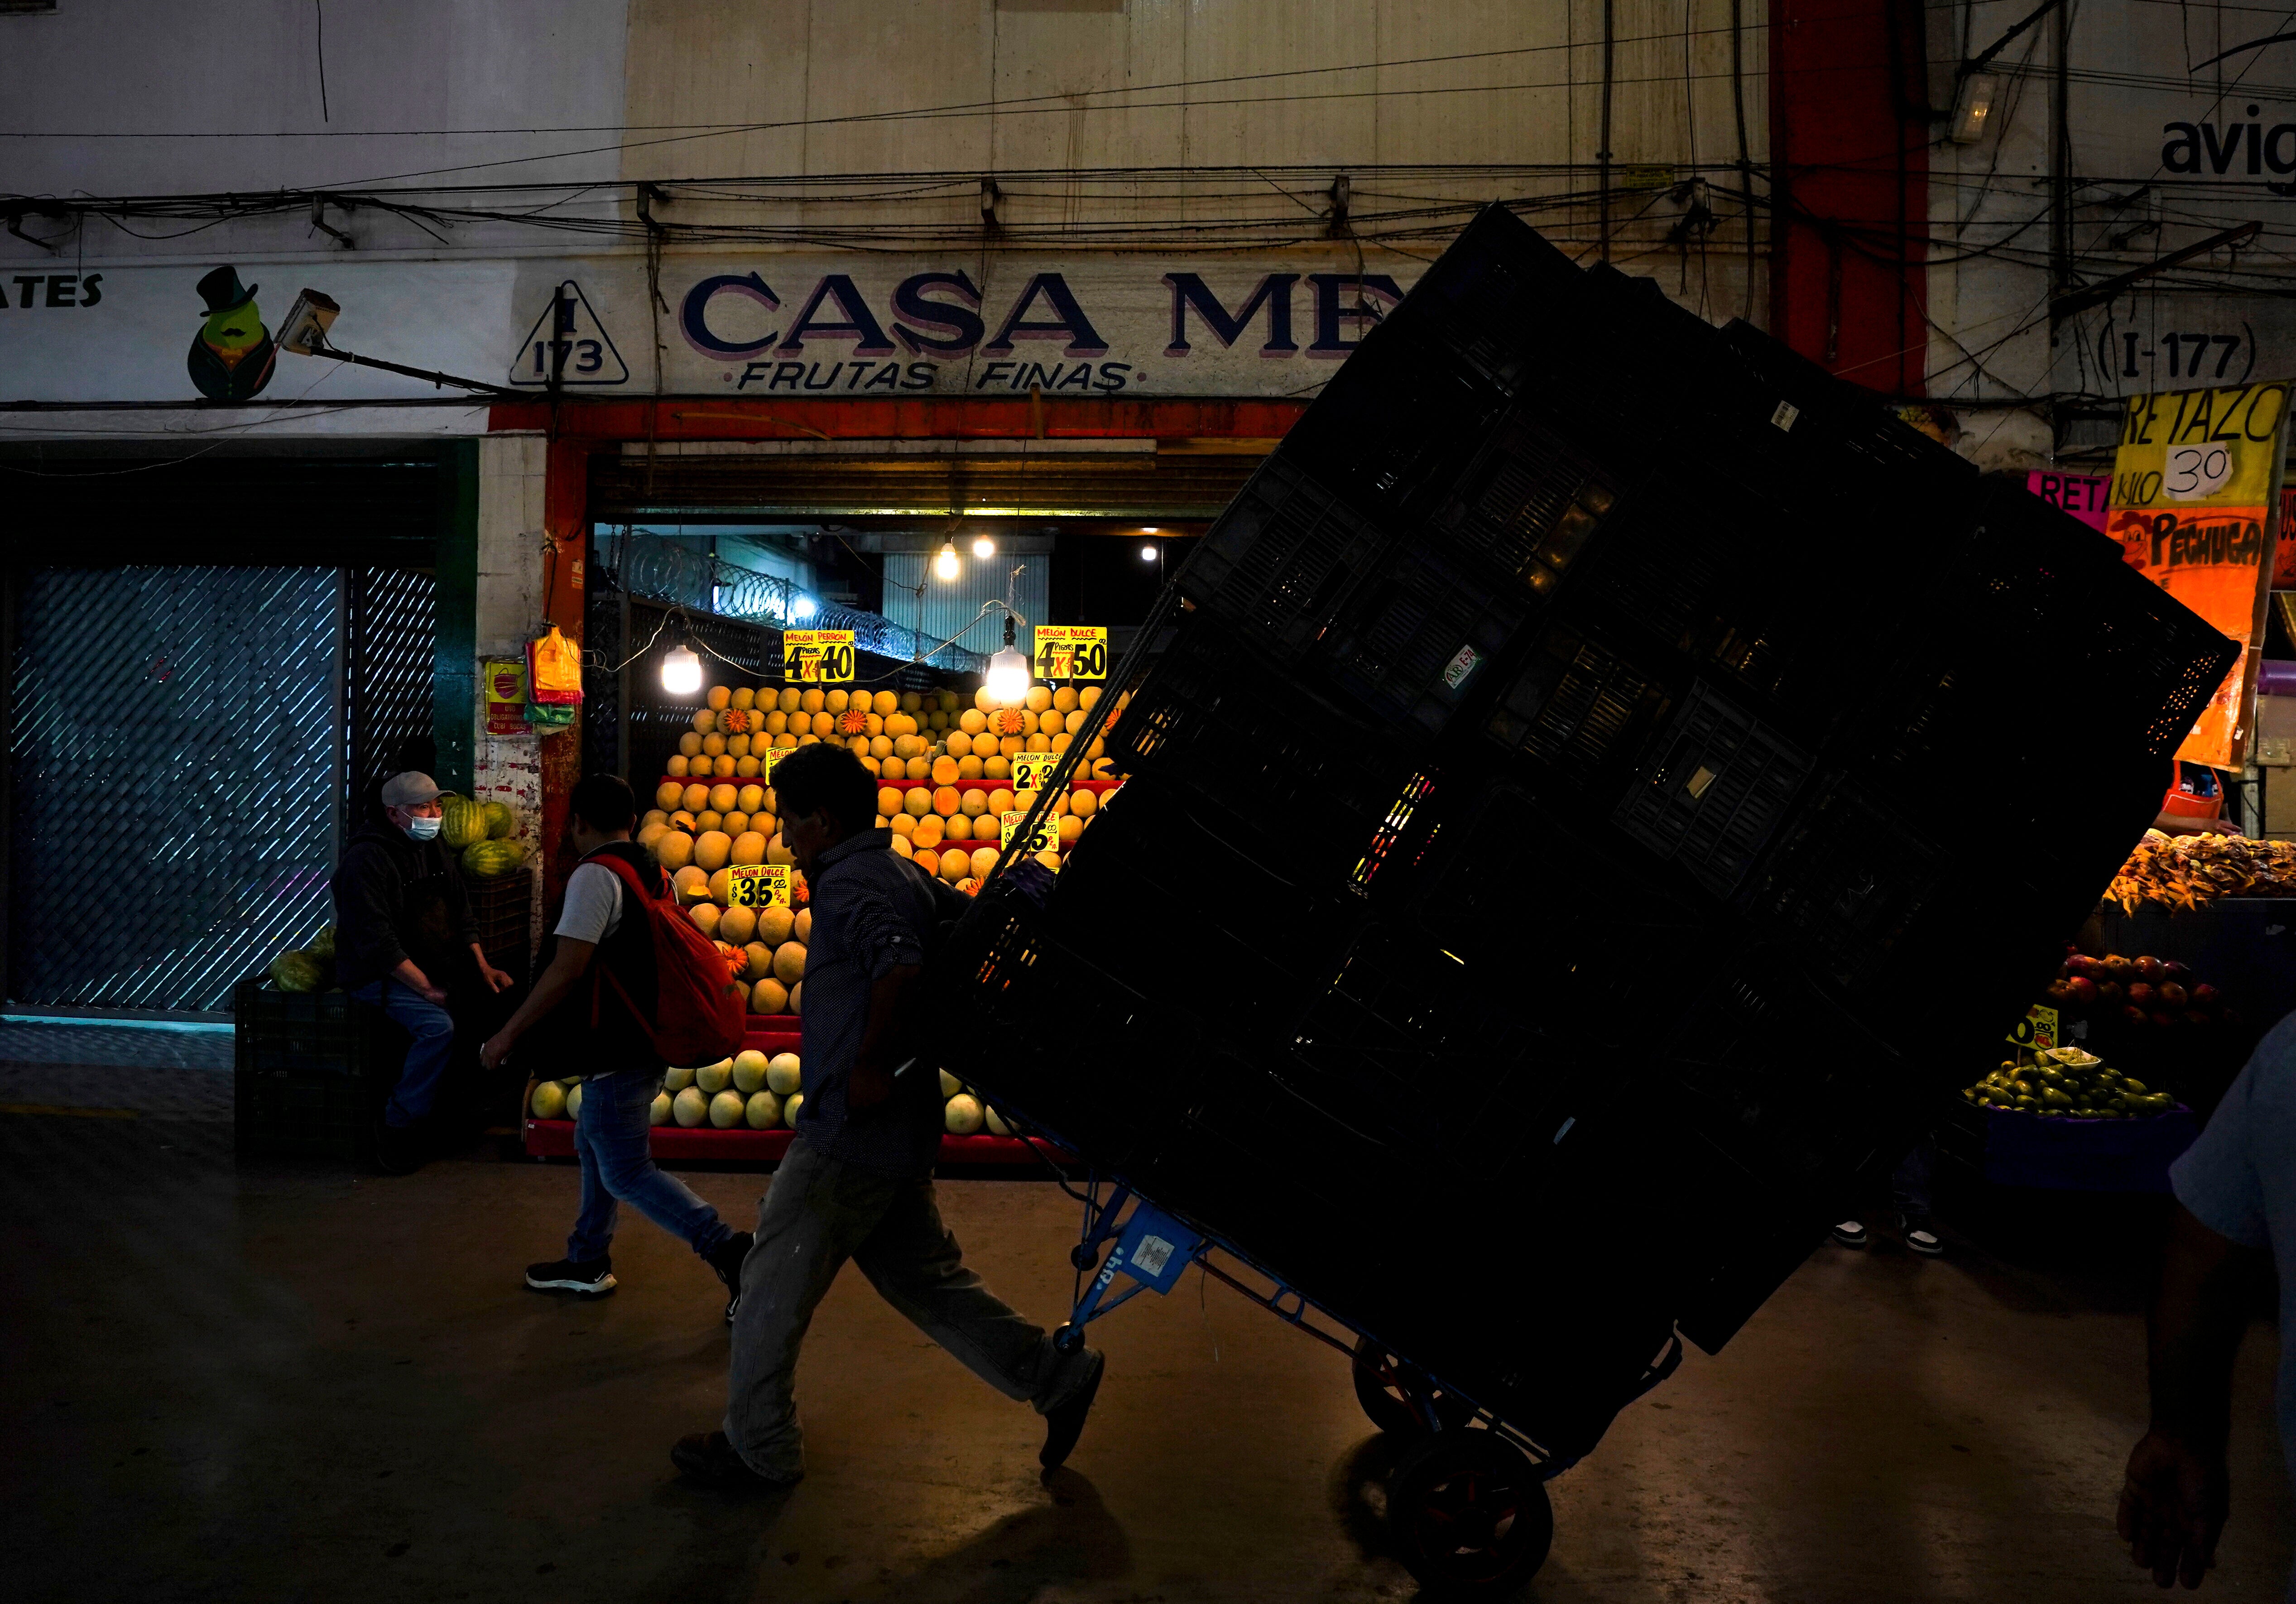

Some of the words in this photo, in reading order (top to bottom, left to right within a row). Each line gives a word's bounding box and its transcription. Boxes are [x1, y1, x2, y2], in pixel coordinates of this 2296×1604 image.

[680, 270, 1109, 359] CASA
[534, 339, 603, 374] 173
[2098, 318, 2256, 384] (I-177)
[737, 362, 938, 390] FRUTAS
[975, 362, 1132, 390] FINAS
[2121, 384, 2287, 444] RETAZO
[2114, 471, 2163, 505] KILO
[2167, 450, 2226, 492] 30
[2151, 513, 2261, 567] PECHUGA
[1071, 628, 1097, 637] DULCE
[785, 646, 803, 679] 4
[1036, 642, 1056, 677] 4
[1016, 765, 1031, 788] 2
[732, 868, 759, 879] MELON
[761, 866, 785, 876] DULCE
